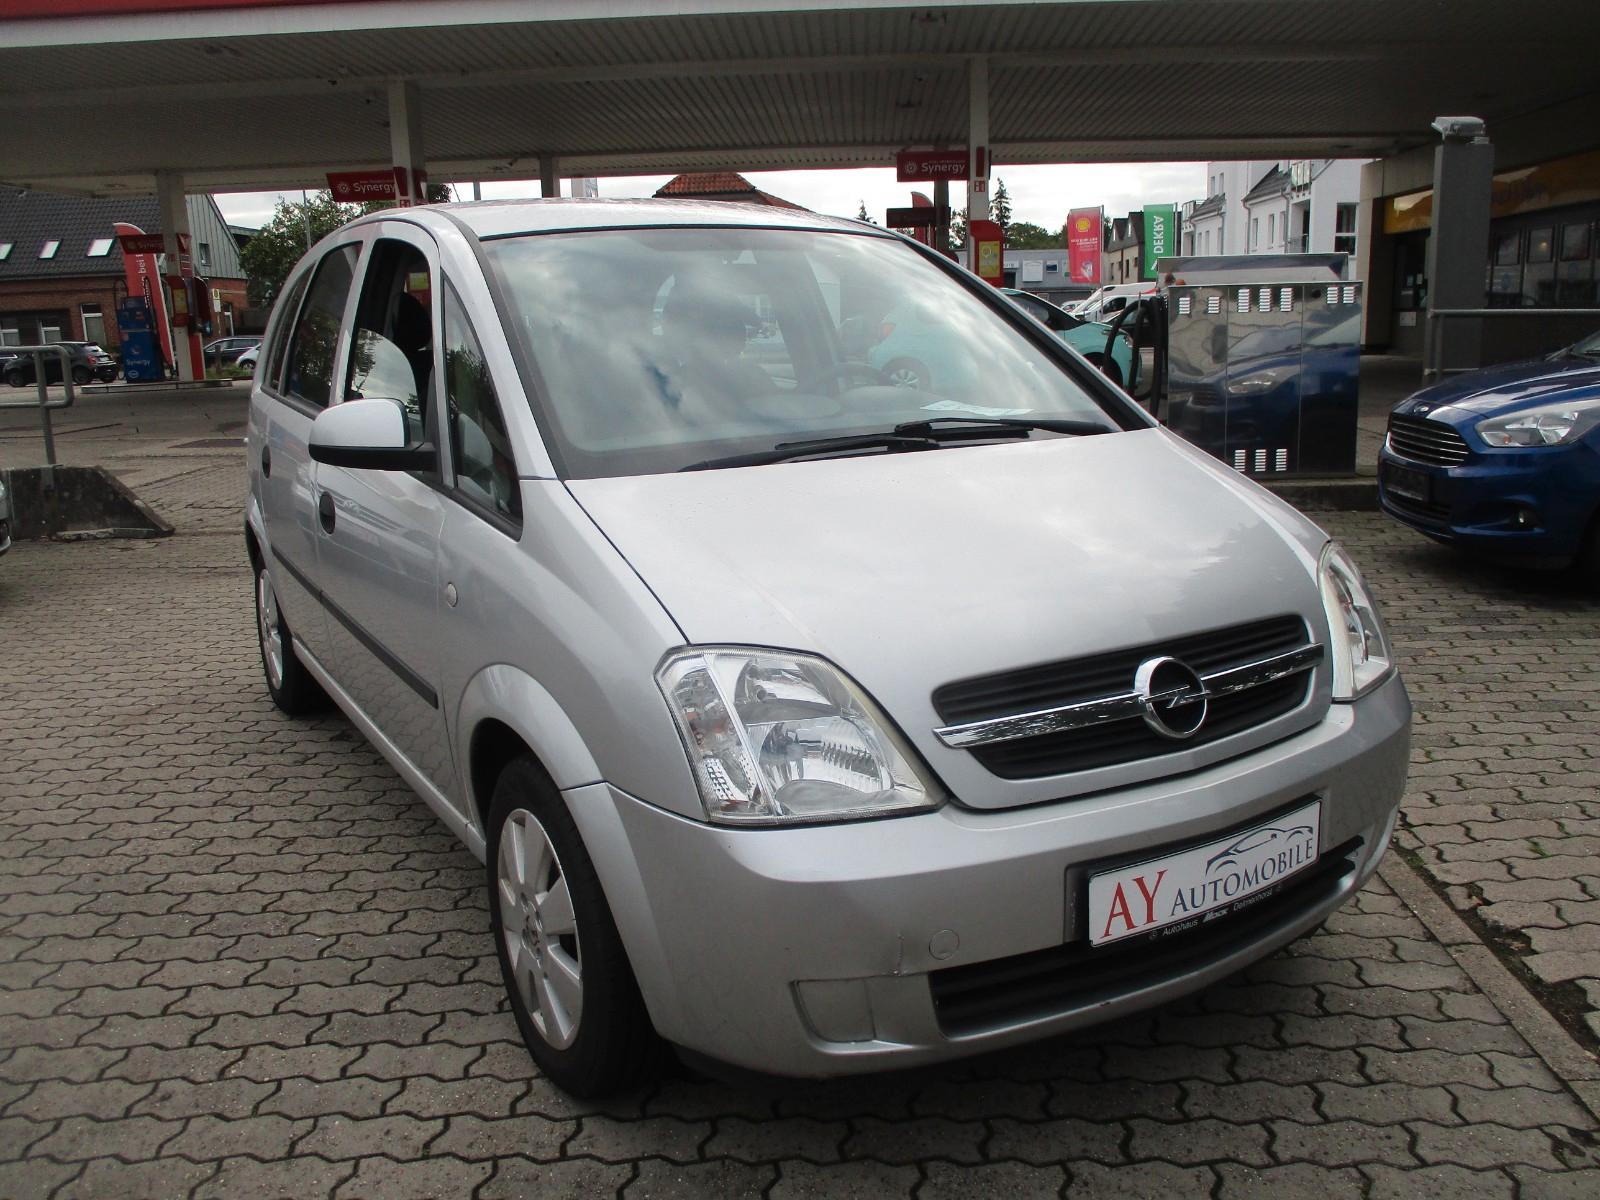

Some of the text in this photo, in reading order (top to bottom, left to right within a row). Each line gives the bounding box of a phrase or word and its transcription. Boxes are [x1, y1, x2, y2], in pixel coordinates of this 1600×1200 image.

[921, 162, 965, 174] Synergy
[353, 182, 396, 193] Synergy
[1099, 838, 1314, 939] AY AUTOMOBILE
[1162, 919, 1199, 937] Autohaus
[1233, 888, 1273, 912] Delmenhorst
